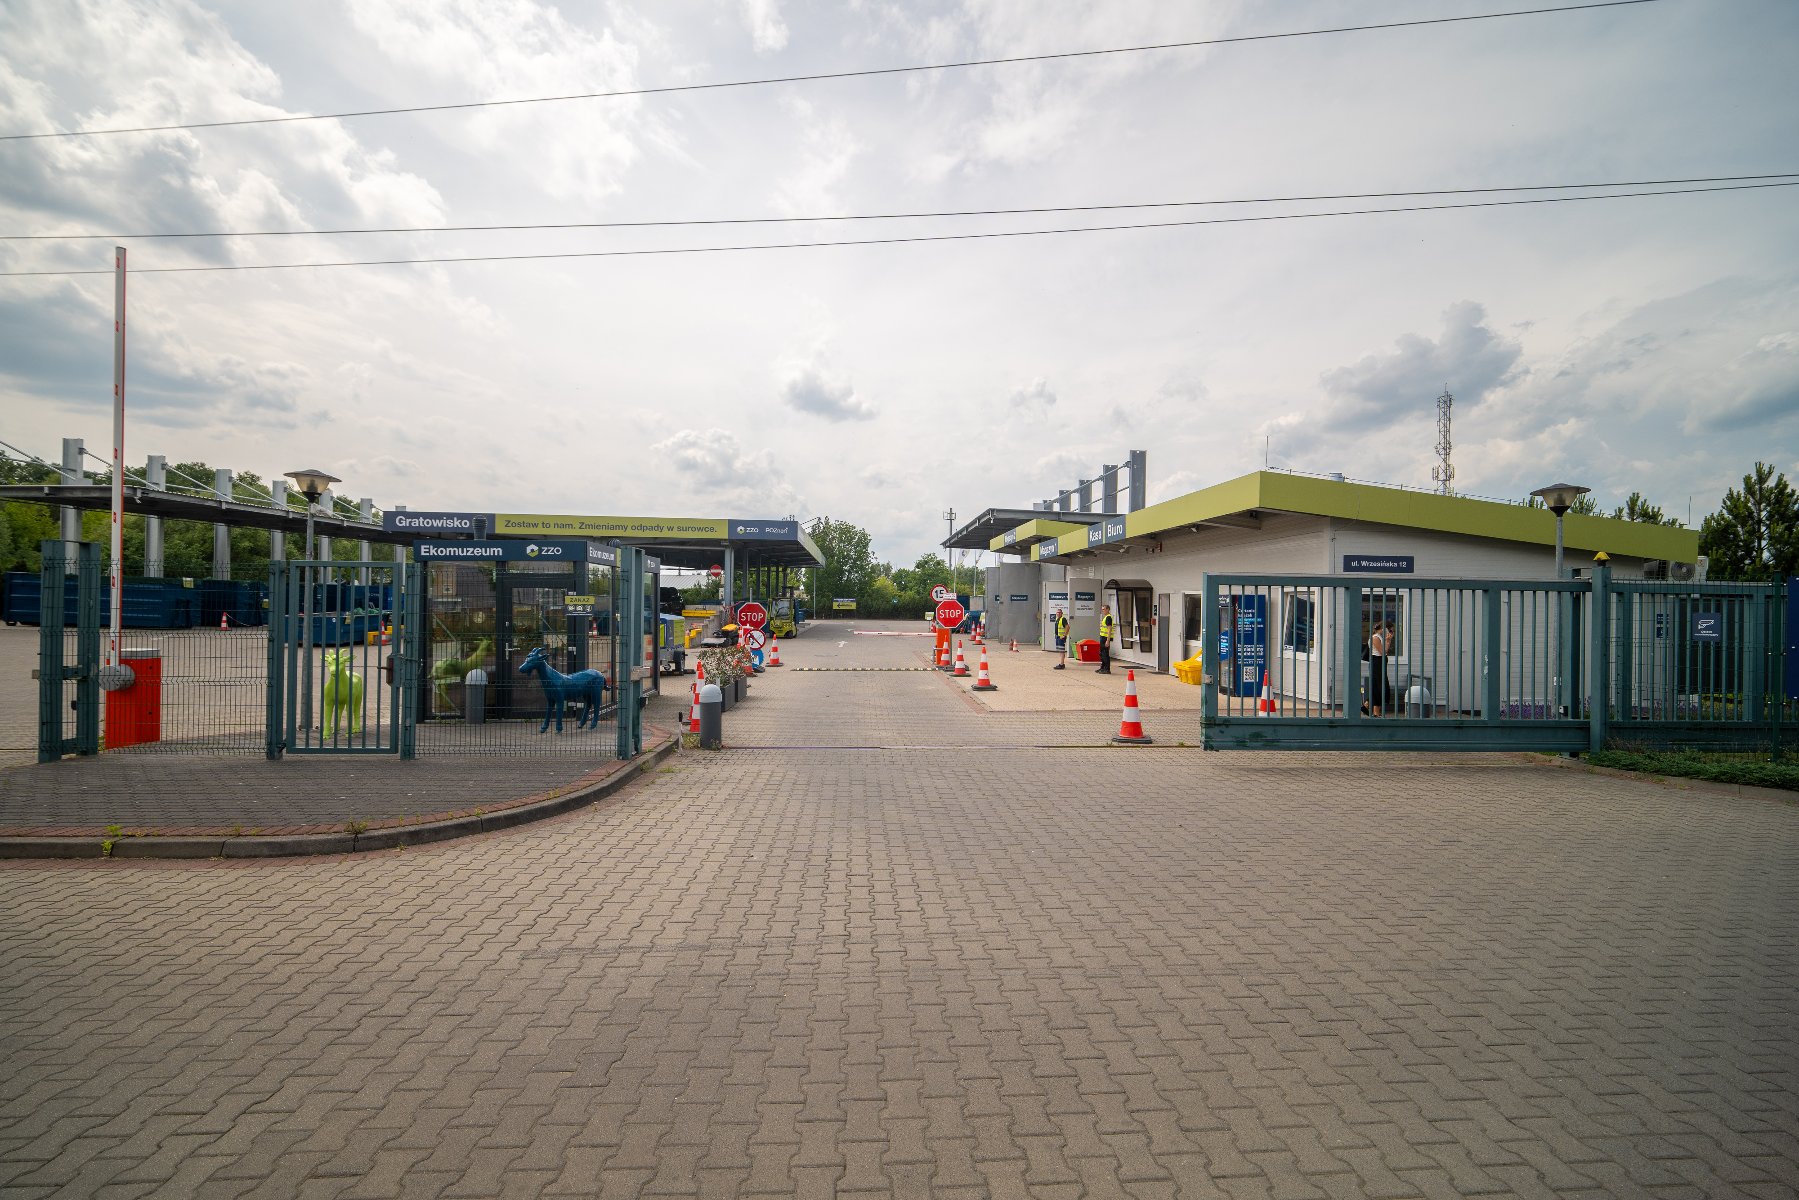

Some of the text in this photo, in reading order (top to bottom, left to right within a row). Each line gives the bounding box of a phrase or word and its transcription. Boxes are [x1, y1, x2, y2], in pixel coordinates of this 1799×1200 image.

[395, 515, 470, 528] Gratowisko
[504, 520, 539, 528] Zostaw
[553, 522, 576, 530] nam.
[578, 522, 628, 532] Zmieniamy
[630, 524, 664, 532] odpady
[676, 524, 717, 532] surowce.
[1090, 530, 1102, 542] Kasa
[1108, 524, 1122, 538] Biuro
[420, 544, 502, 556] Ekomuzeum
[935, 590, 944, 598] 15
[740, 612, 764, 621] STOP
[940, 610, 961, 618] STOP
